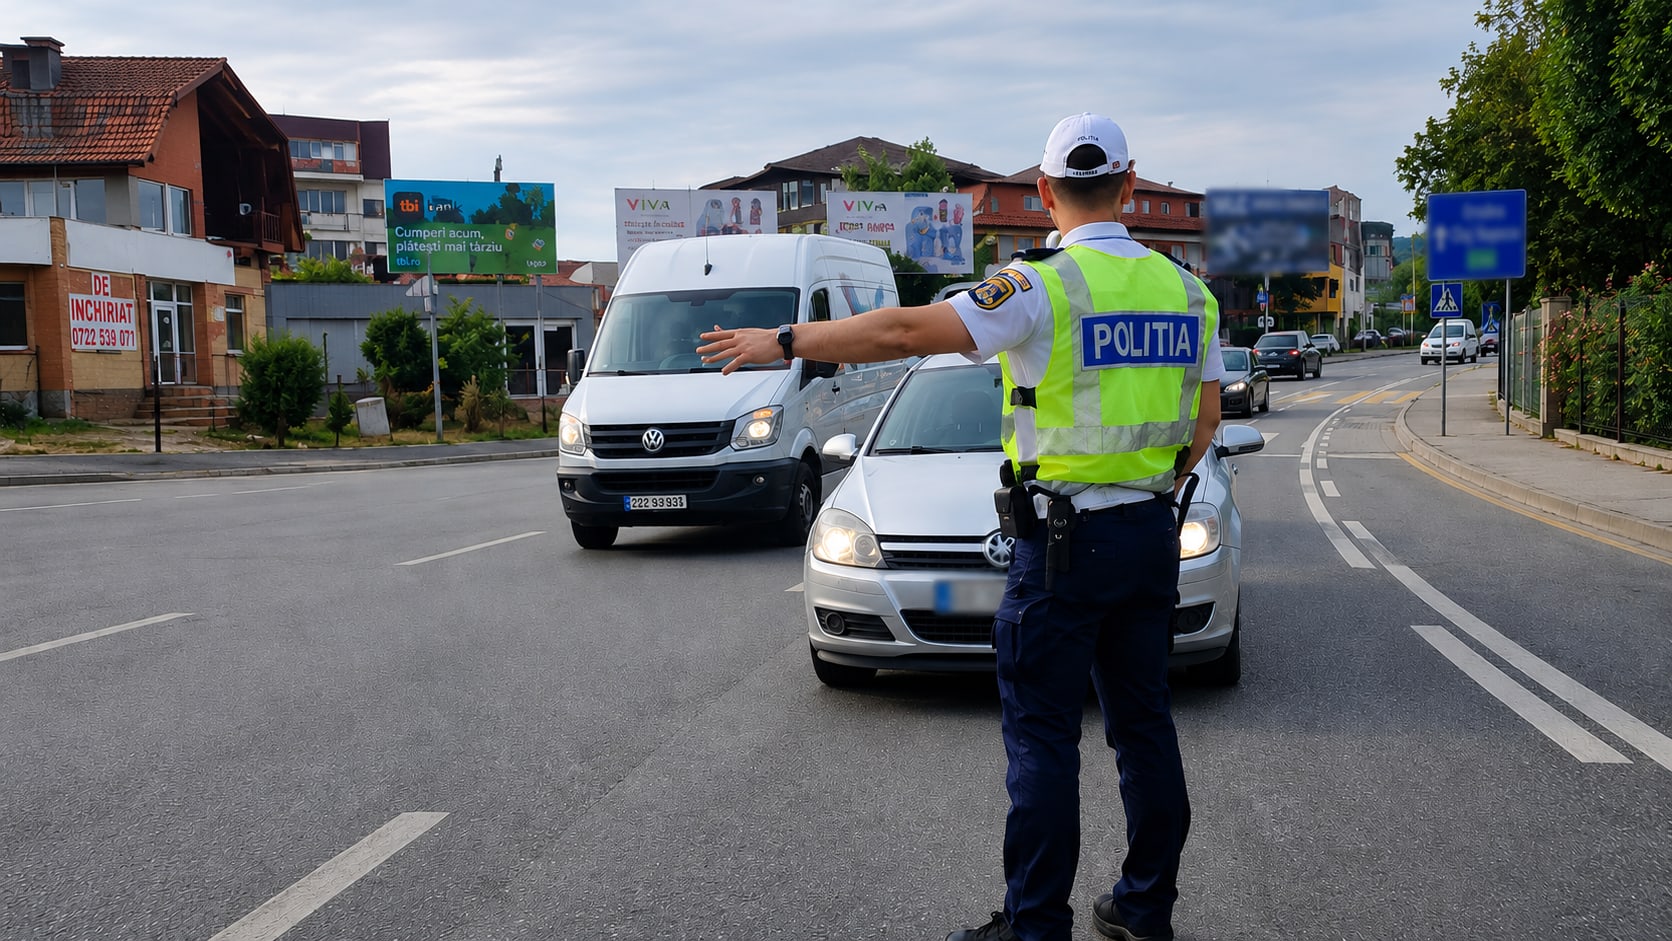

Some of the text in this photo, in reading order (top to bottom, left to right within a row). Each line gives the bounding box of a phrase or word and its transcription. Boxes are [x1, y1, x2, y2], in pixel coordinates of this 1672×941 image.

[399, 199, 419, 213] tbi
[626, 198, 671, 211] VIVA
[395, 226, 485, 240] Cumperi acum,
[444, 241, 466, 252] mai
[93, 274, 109, 296] DE
[71, 298, 133, 324] INCHIRIAT
[72, 327, 135, 347] 0722 539 071
[1093, 321, 1192, 360] POLITIA
[631, 497, 649, 508] 222
